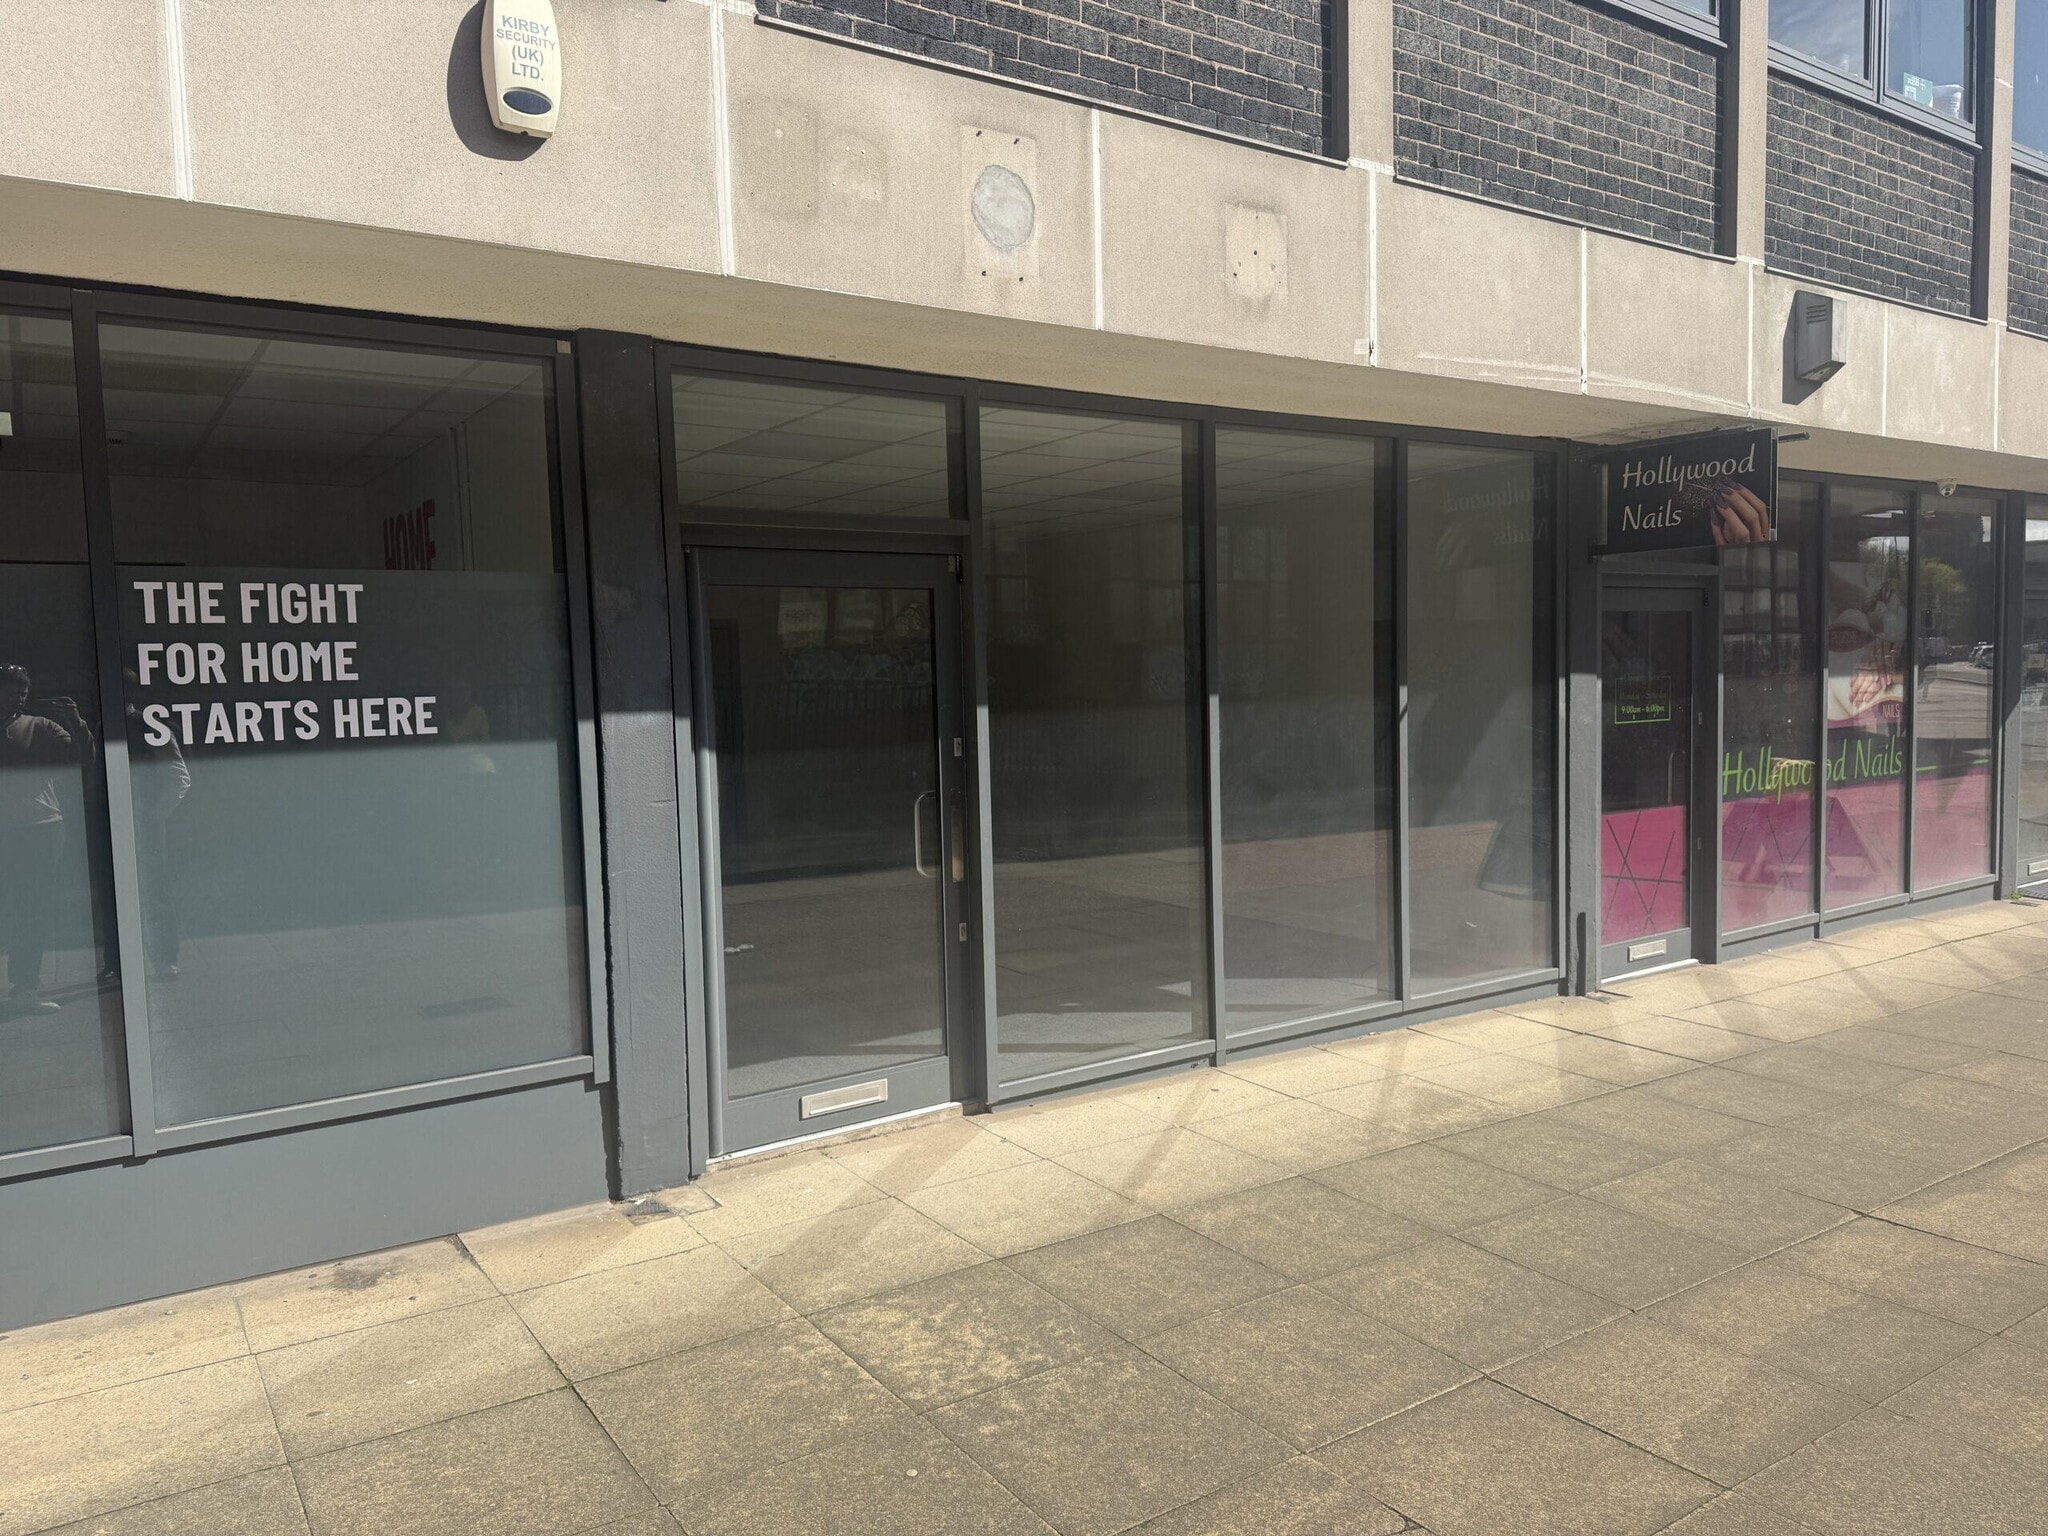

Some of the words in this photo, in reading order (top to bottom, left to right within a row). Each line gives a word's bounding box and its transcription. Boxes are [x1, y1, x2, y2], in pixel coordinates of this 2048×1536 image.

[496, 28, 556, 51] SECURITY
[502, 15, 550, 36] KIRBY
[512, 45, 544, 66] (UK)
[512, 62, 544, 81] LTD.
[1622, 442, 1756, 491] Hollywood
[383, 498, 437, 570] HOME
[1621, 498, 1683, 532] Nails
[133, 581, 226, 624] THE
[240, 582, 364, 624] FIGHT
[137, 642, 228, 686] FOR
[241, 641, 359, 684] HOME
[142, 699, 320, 747] STARTS
[333, 696, 439, 739] HERE
[1882, 703, 1900, 718] NAILS
[1854, 734, 1903, 779] Nails
